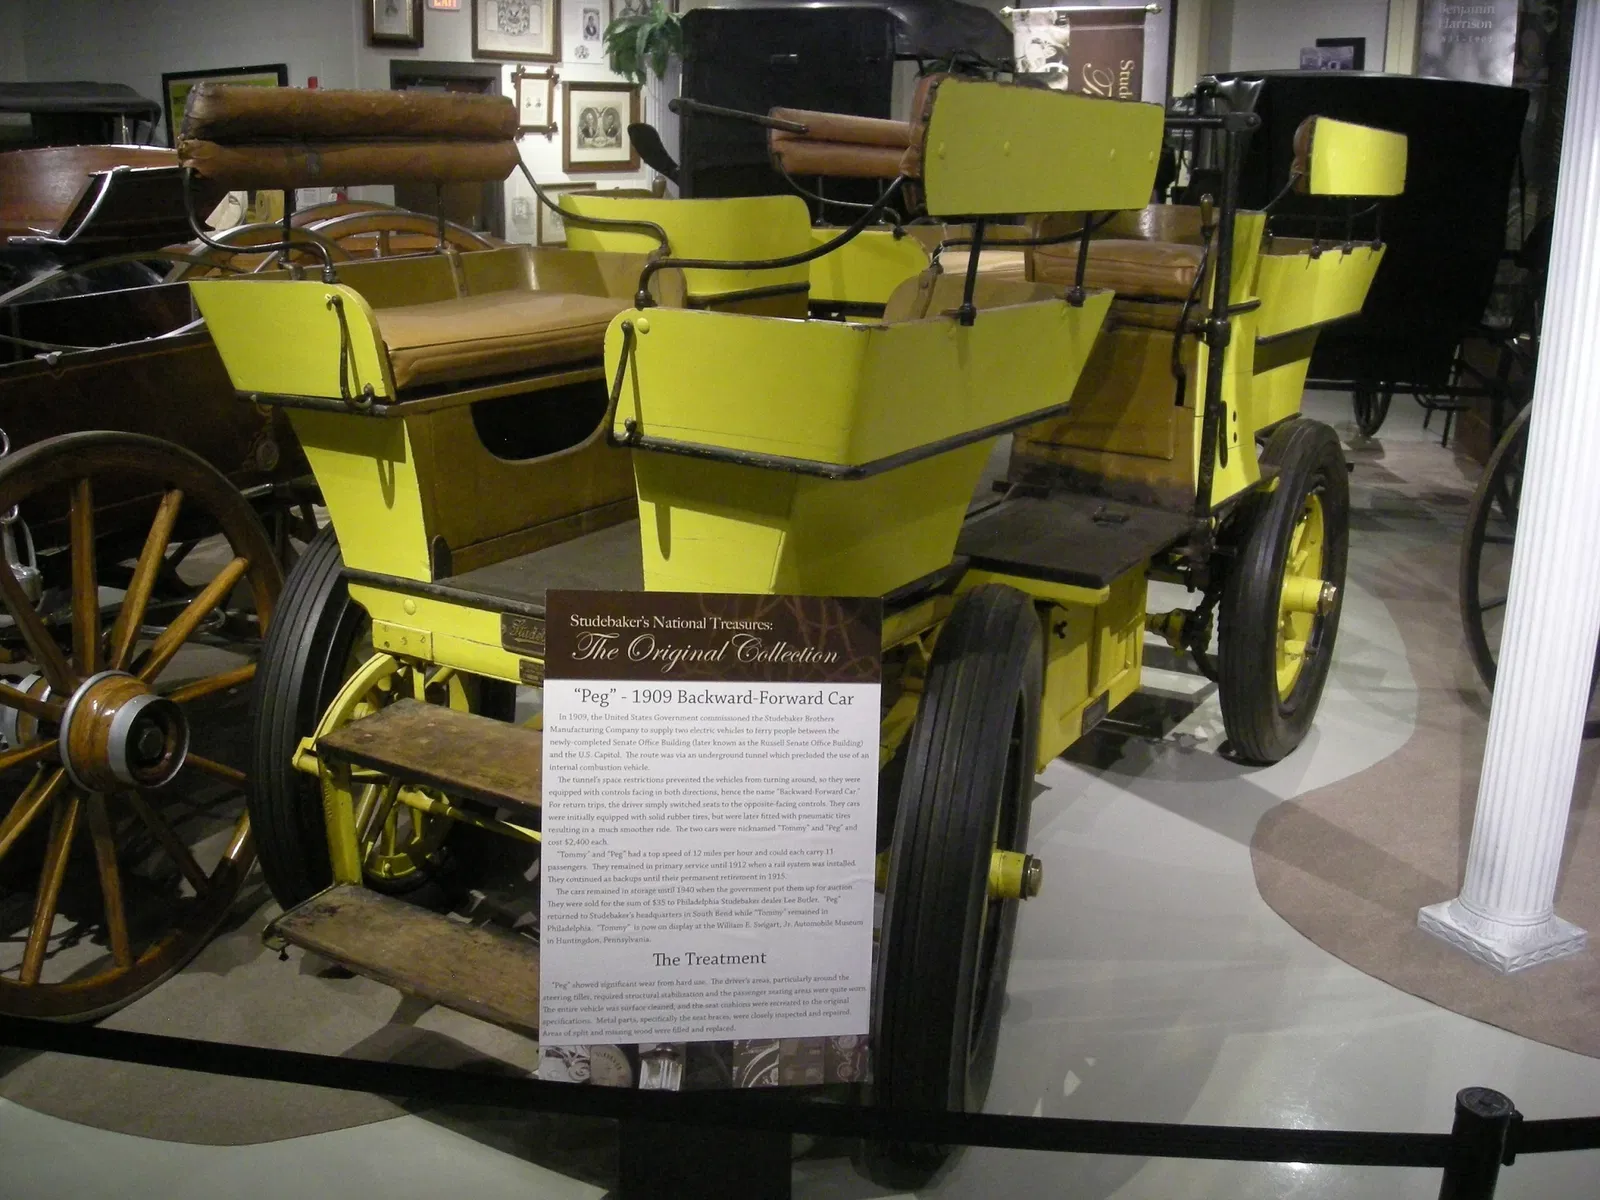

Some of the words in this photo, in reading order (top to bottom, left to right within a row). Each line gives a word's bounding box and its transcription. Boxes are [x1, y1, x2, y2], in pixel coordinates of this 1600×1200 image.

[1440, 18, 1492, 29] Harrison
[570, 614, 650, 628] Studebaker's
[653, 616, 706, 629] National
[709, 617, 773, 630] Treasures:
[572, 632, 620, 660] The
[628, 633, 730, 673] Original
[732, 633, 839, 663] Collection
[632, 690, 672, 704] 1909
[678, 690, 823, 705] Backward-Forward
[828, 692, 855, 705] Car
[559, 713, 567, 722] In
[569, 713, 590, 723] 1909,
[590, 713, 604, 722] the
[604, 713, 629, 722] United
[630, 713, 652, 722] States
[654, 713, 698, 722] Government
[700, 713, 750, 722] commissioned
[751, 714, 764, 722] the
[764, 714, 803, 722] Studebaker
[805, 714, 834, 722] Brothers
[550, 725, 604, 736] Manufacturing
[605, 725, 640, 736] Company
[650, 726, 674, 737] supply
[689, 726, 715, 734] electric
[717, 726, 744, 734] vehicles
[754, 726, 773, 737] ferry
[773, 726, 797, 737] people
[797, 726, 827, 735] between
[828, 726, 839, 735] the
[550, 738, 611, 749] newly-completed
[612, 738, 637, 746] Senate
[638, 738, 659, 746] Office
[661, 738, 691, 749] Building
[692, 738, 711, 749] (later
[712, 738, 737, 746] known
[747, 738, 759, 747] the
[760, 738, 785, 747] Russell
[786, 738, 810, 747] Senate
[810, 738, 831, 747] Office
[832, 738, 863, 749] Building)
[550, 750, 564, 759] and
[564, 750, 577, 759] the
[578, 750, 594, 759] U.S.
[594, 750, 625, 761] Capitol.
[625, 750, 639, 759] The
[639, 751, 659, 759] route
[676, 750, 686, 759] via
[698, 750, 744, 761] underground
[745, 750, 768, 759] tunnel
[769, 750, 790, 759] which
[791, 750, 825, 762] precluded
[826, 750, 838, 759] the
[852, 750, 860, 759] of
[549, 762, 578, 771] internal
[579, 762, 622, 771] combustion
[623, 762, 650, 771] vehicle.
[557, 775, 571, 783] The
[572, 775, 601, 783] tunnel's
[602, 777, 622, 786] space
[623, 775, 664, 783] restrictions
[665, 775, 701, 786] prevented
[702, 775, 714, 783] the
[716, 775, 743, 783] vehicles
[745, 775, 762, 783] from
[763, 775, 790, 786] turning
[791, 775, 817, 784] around,
[828, 775, 843, 786] they
[567, 812, 595, 823] initially
[596, 812, 629, 823] equipped
[630, 812, 647, 821] with
[648, 812, 666, 821] solid
[666, 812, 690, 821] rubber
[692, 812, 710, 822] tires,
[711, 812, 724, 820] but
[743, 812, 759, 820] later
[760, 812, 780, 820] fitted
[781, 812, 797, 820] with
[798, 811, 835, 822] pneumatic
[835, 811, 851, 820] tires
[564, 837, 590, 847] $2,400
[547, 864, 588, 873] passengers.
[593, 862, 610, 873] They
[610, 861, 645, 870] remained
[645, 861, 653, 870] in
[654, 861, 683, 872] primary
[684, 861, 709, 869] service
[710, 860, 728, 869] until
[729, 860, 747, 869] 1912
[748, 860, 767, 869] when
[773, 860, 786, 868] rail
[787, 861, 811, 871] system
[548, 874, 565, 885] They
[565, 874, 603, 882] continued
[612, 873, 642, 884] backups
[643, 873, 661, 882] until
[661, 873, 679, 881] their
[680, 873, 719, 884] permanent
[720, 872, 758, 881] retirement
[759, 872, 767, 880] in
[768, 871, 787, 880] 1915.
[547, 936, 554, 944] in
[603, 935, 652, 946] Pennsylvania.
[653, 953, 680, 966] The
[685, 952, 767, 966] Treatment
[572, 979, 599, 988] showed
[600, 978, 637, 990] significant
[657, 977, 675, 986] from
[675, 976, 692, 986] hard
[711, 976, 724, 984] The
[772, 973, 812, 985] particularly
[813, 973, 837, 982] around
[838, 972, 849, 981] the
[543, 1027, 562, 1036] Areas
[564, 1027, 572, 1036] of
[572, 1027, 589, 1038] split
[590, 1026, 604, 1035] and
[605, 1026, 633, 1037] missing
[633, 1026, 653, 1034] wood
[672, 1025, 690, 1034] filled
[691, 1024, 705, 1033] and
[706, 1024, 736, 1035] replaced.
